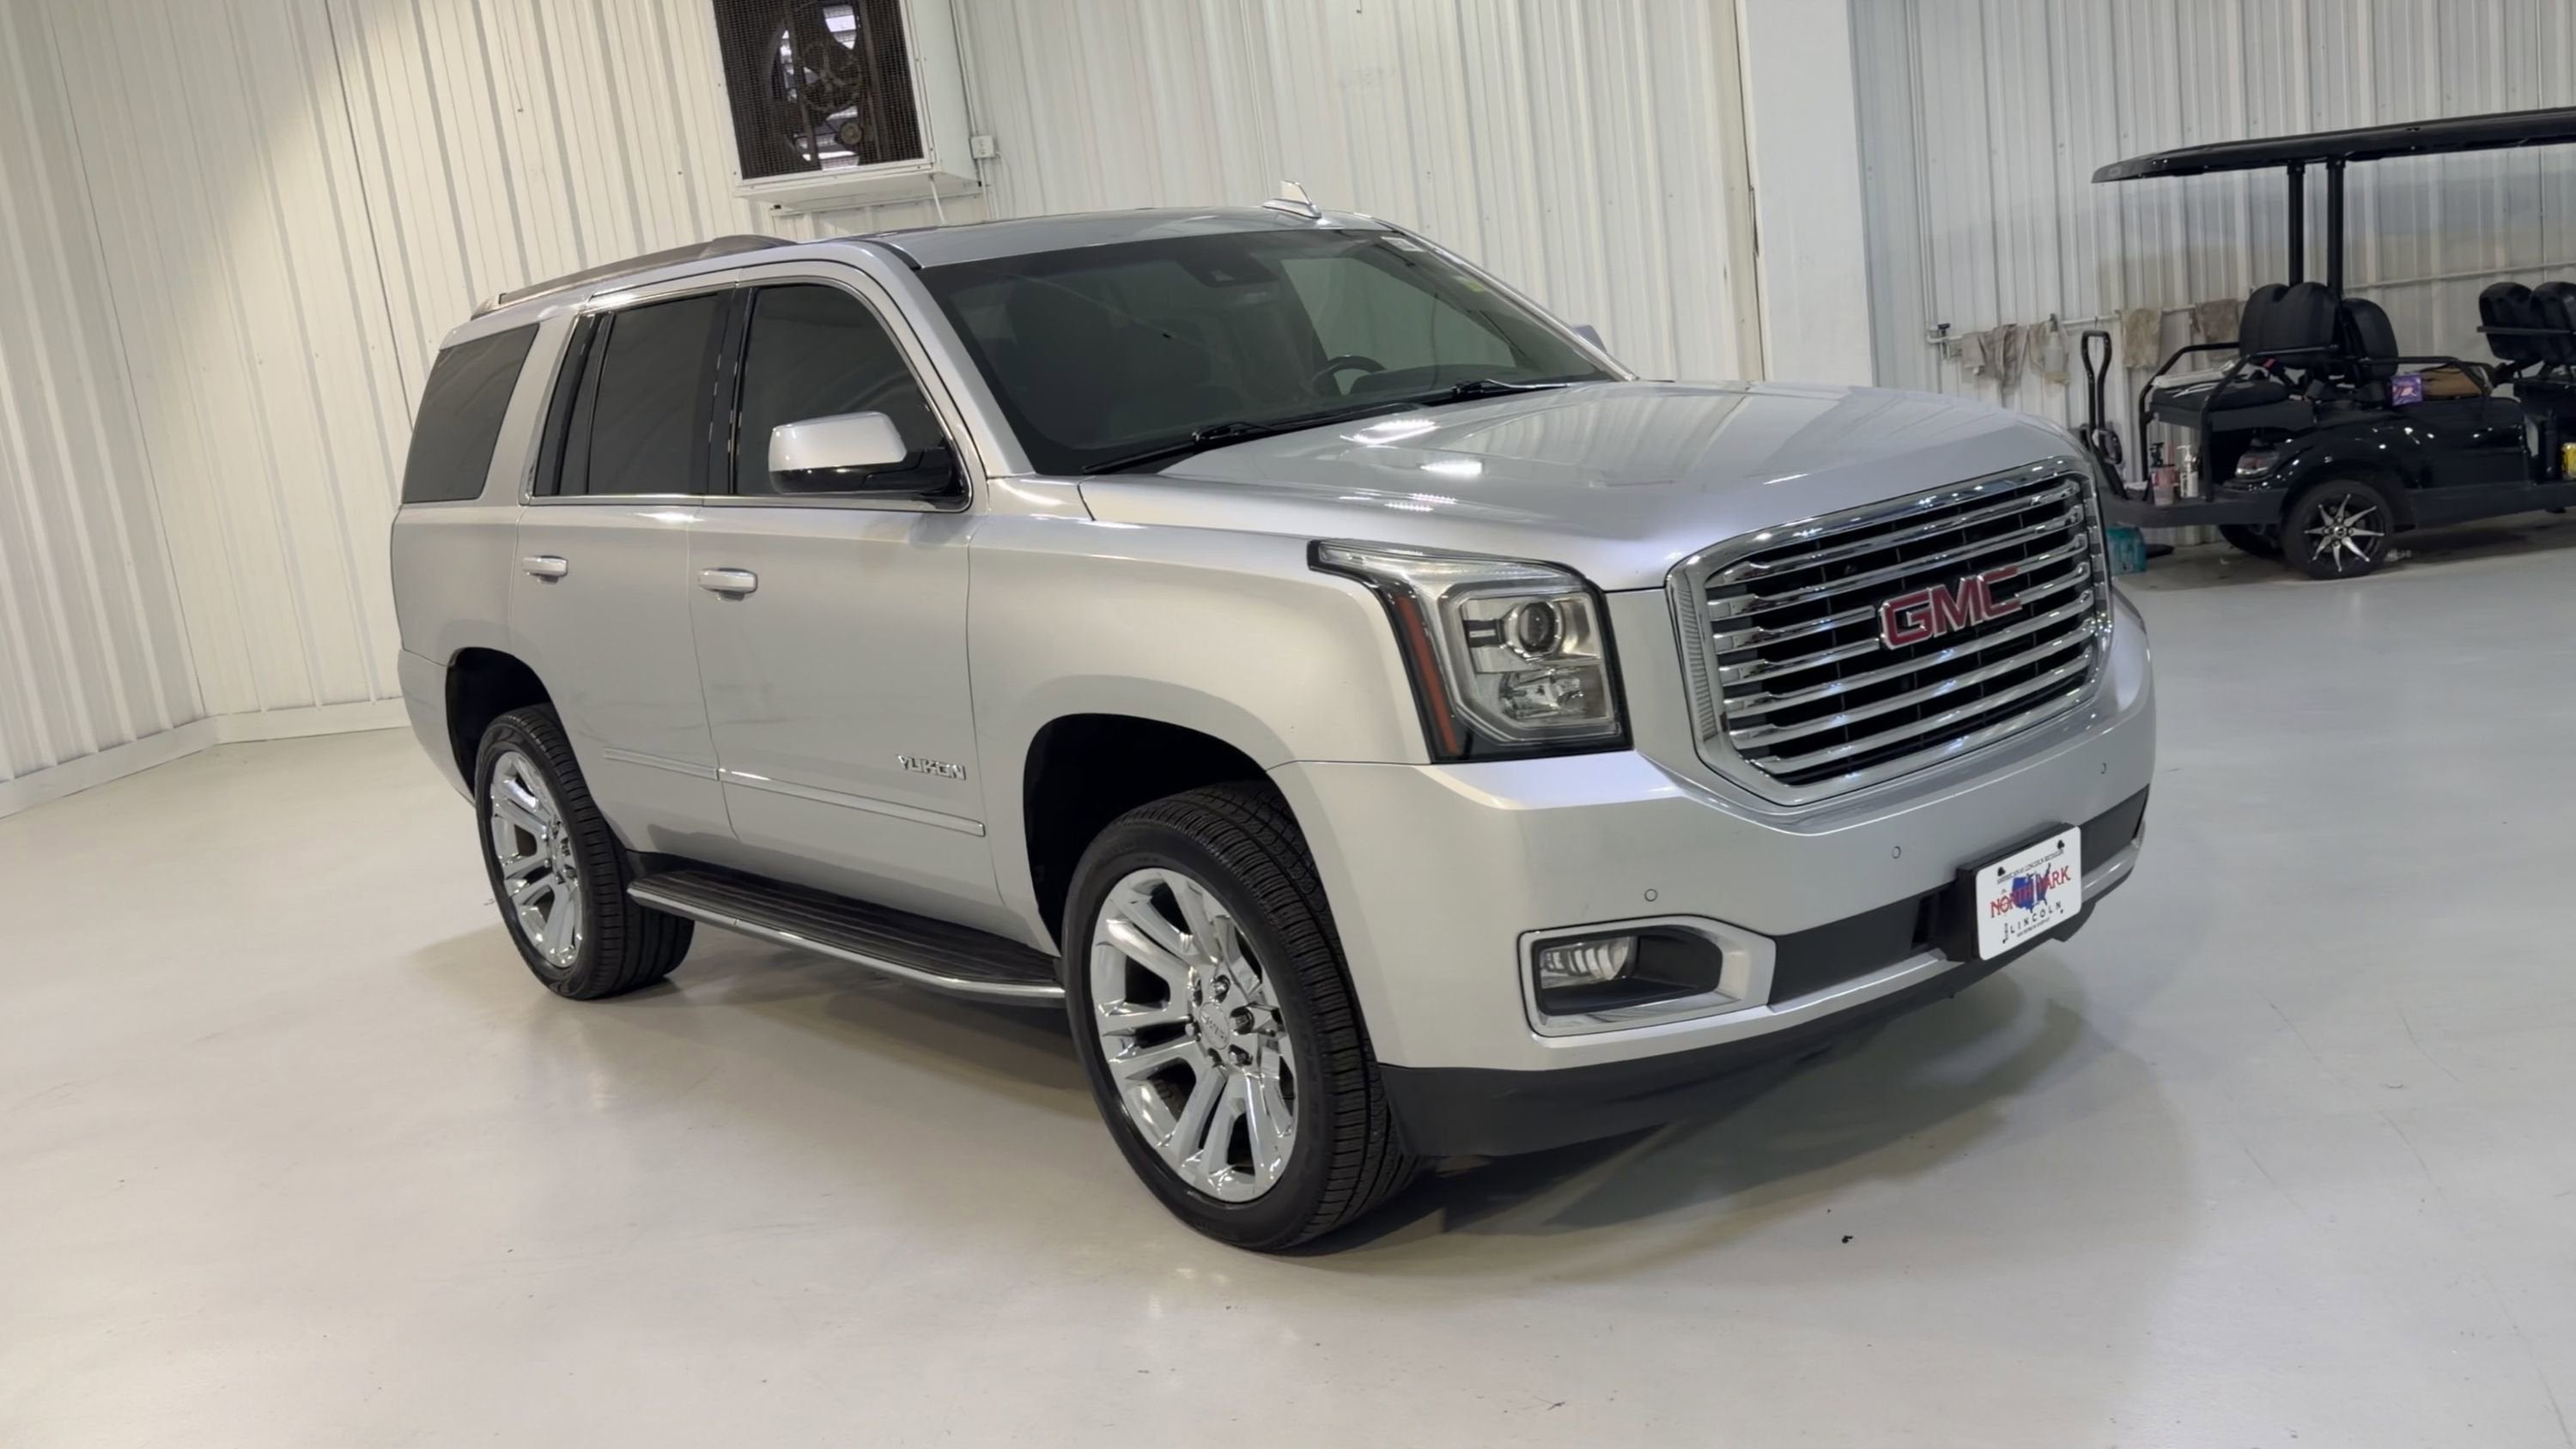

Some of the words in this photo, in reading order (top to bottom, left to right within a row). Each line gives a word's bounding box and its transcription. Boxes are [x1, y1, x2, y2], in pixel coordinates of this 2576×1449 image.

[1879, 565, 2023, 650] GMC
[897, 755, 967, 781] YUKON
[2009, 900, 2062, 934] LINCOLN
